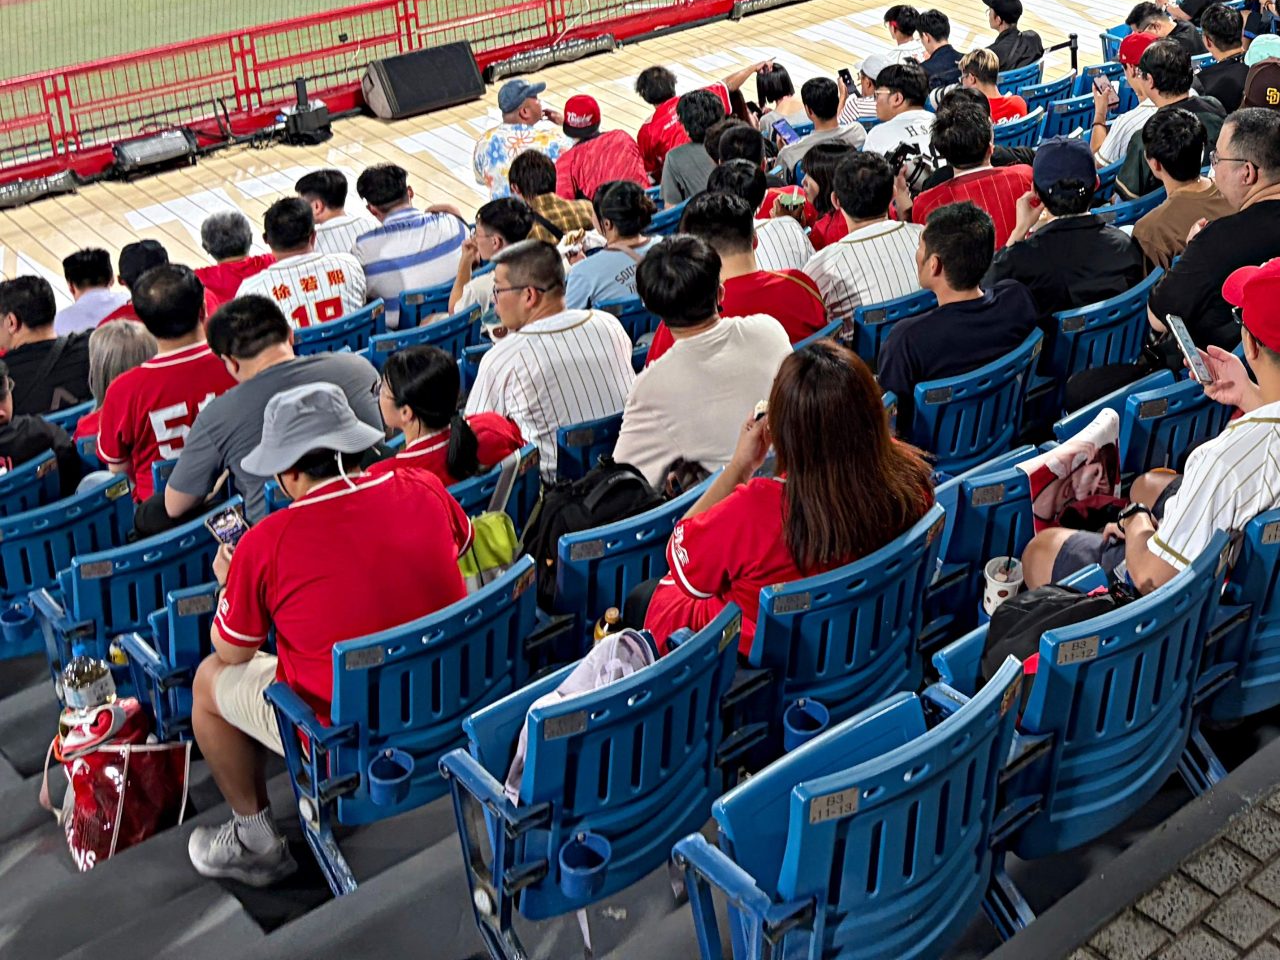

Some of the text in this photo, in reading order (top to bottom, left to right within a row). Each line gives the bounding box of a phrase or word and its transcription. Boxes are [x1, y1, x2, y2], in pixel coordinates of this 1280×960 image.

[1266, 87, 1280, 105] SD
[272, 268, 346, 302] 徐若熙
[1071, 640, 1087, 651] B3
[1063, 648, 1097, 662] 11-12
[826, 794, 845, 807] B3
[817, 801, 852, 819] 11-13
